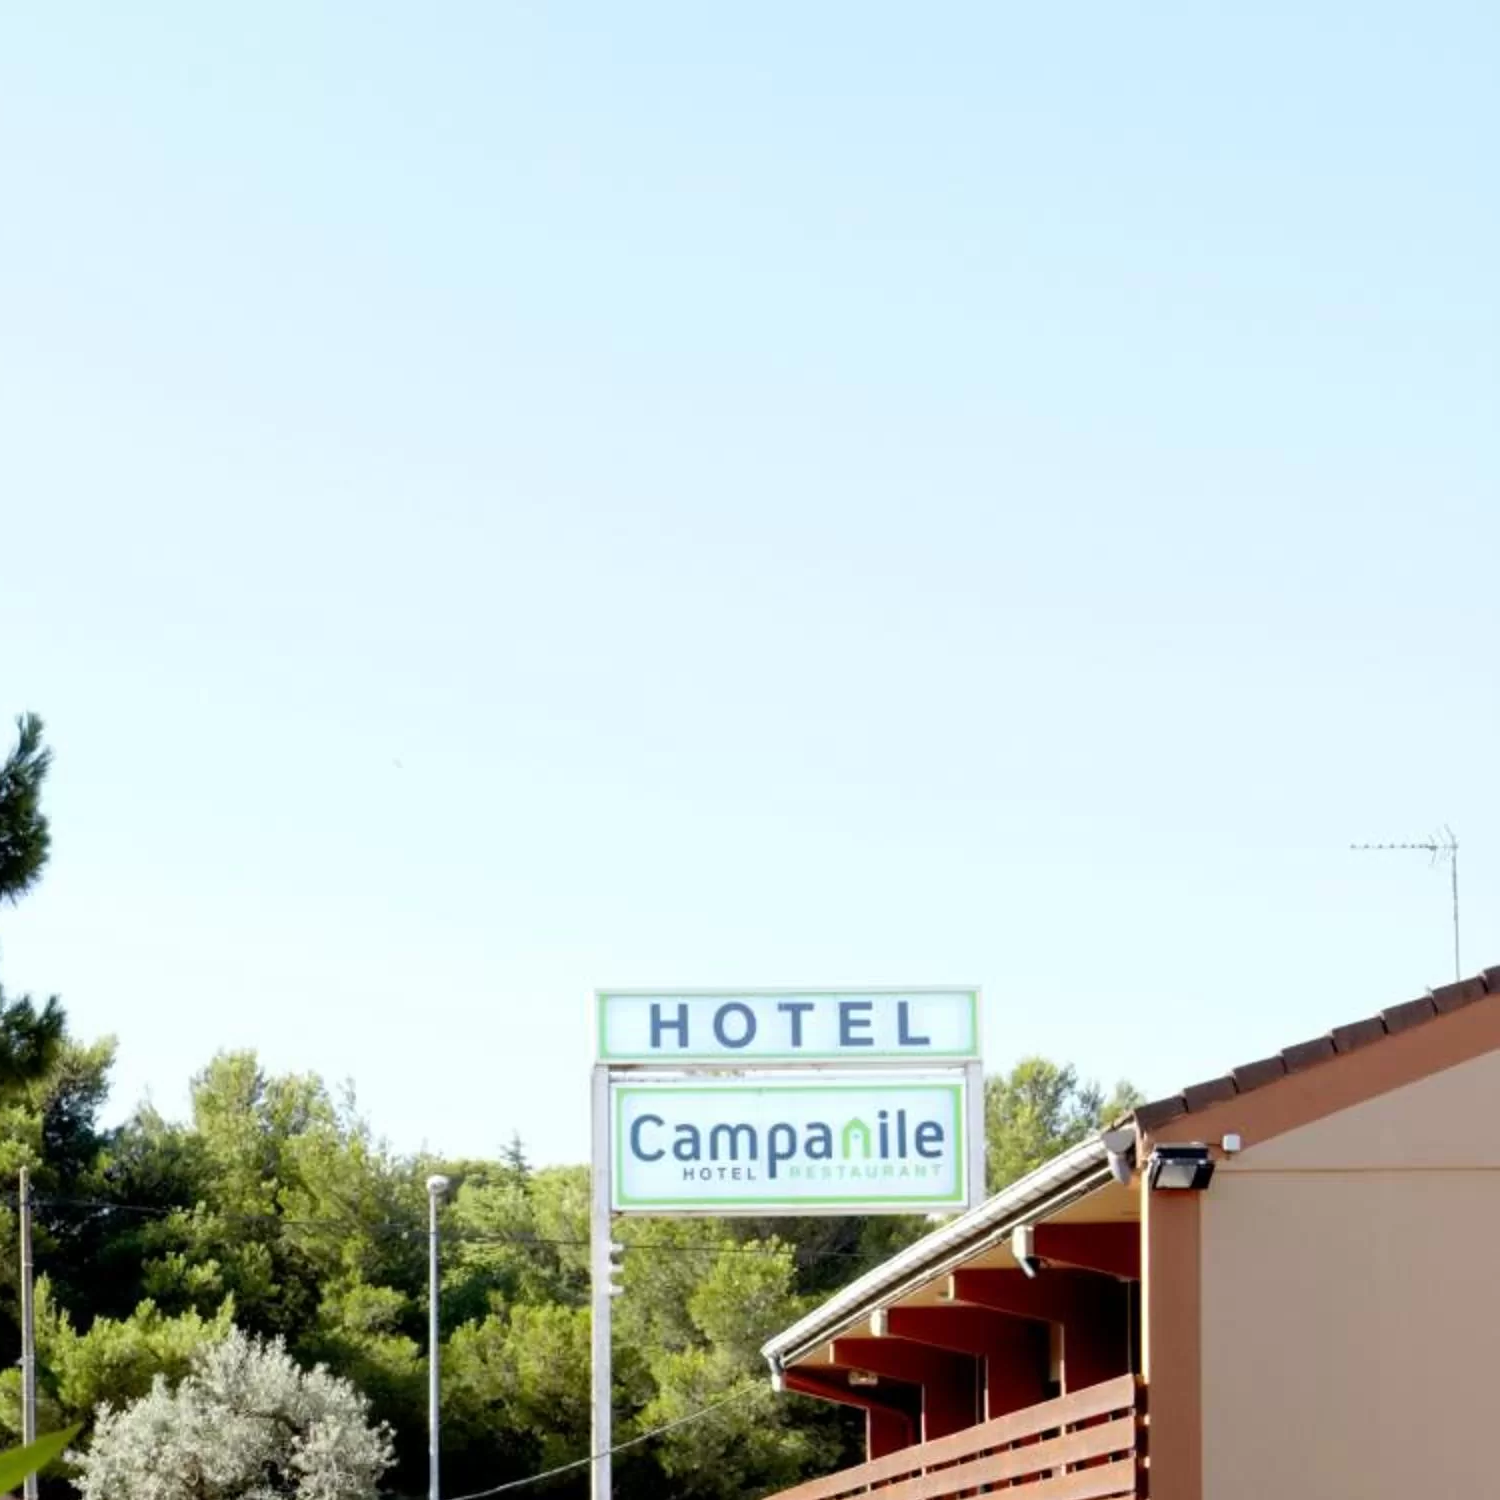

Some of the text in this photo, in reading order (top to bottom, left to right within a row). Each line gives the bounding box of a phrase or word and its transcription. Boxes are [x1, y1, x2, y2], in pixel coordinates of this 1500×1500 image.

[649, 1000, 931, 1049] HOTEL
[630, 1109, 945, 1179] Campanile
[682, 1163, 943, 1181] HOTEL RESTAURANT
